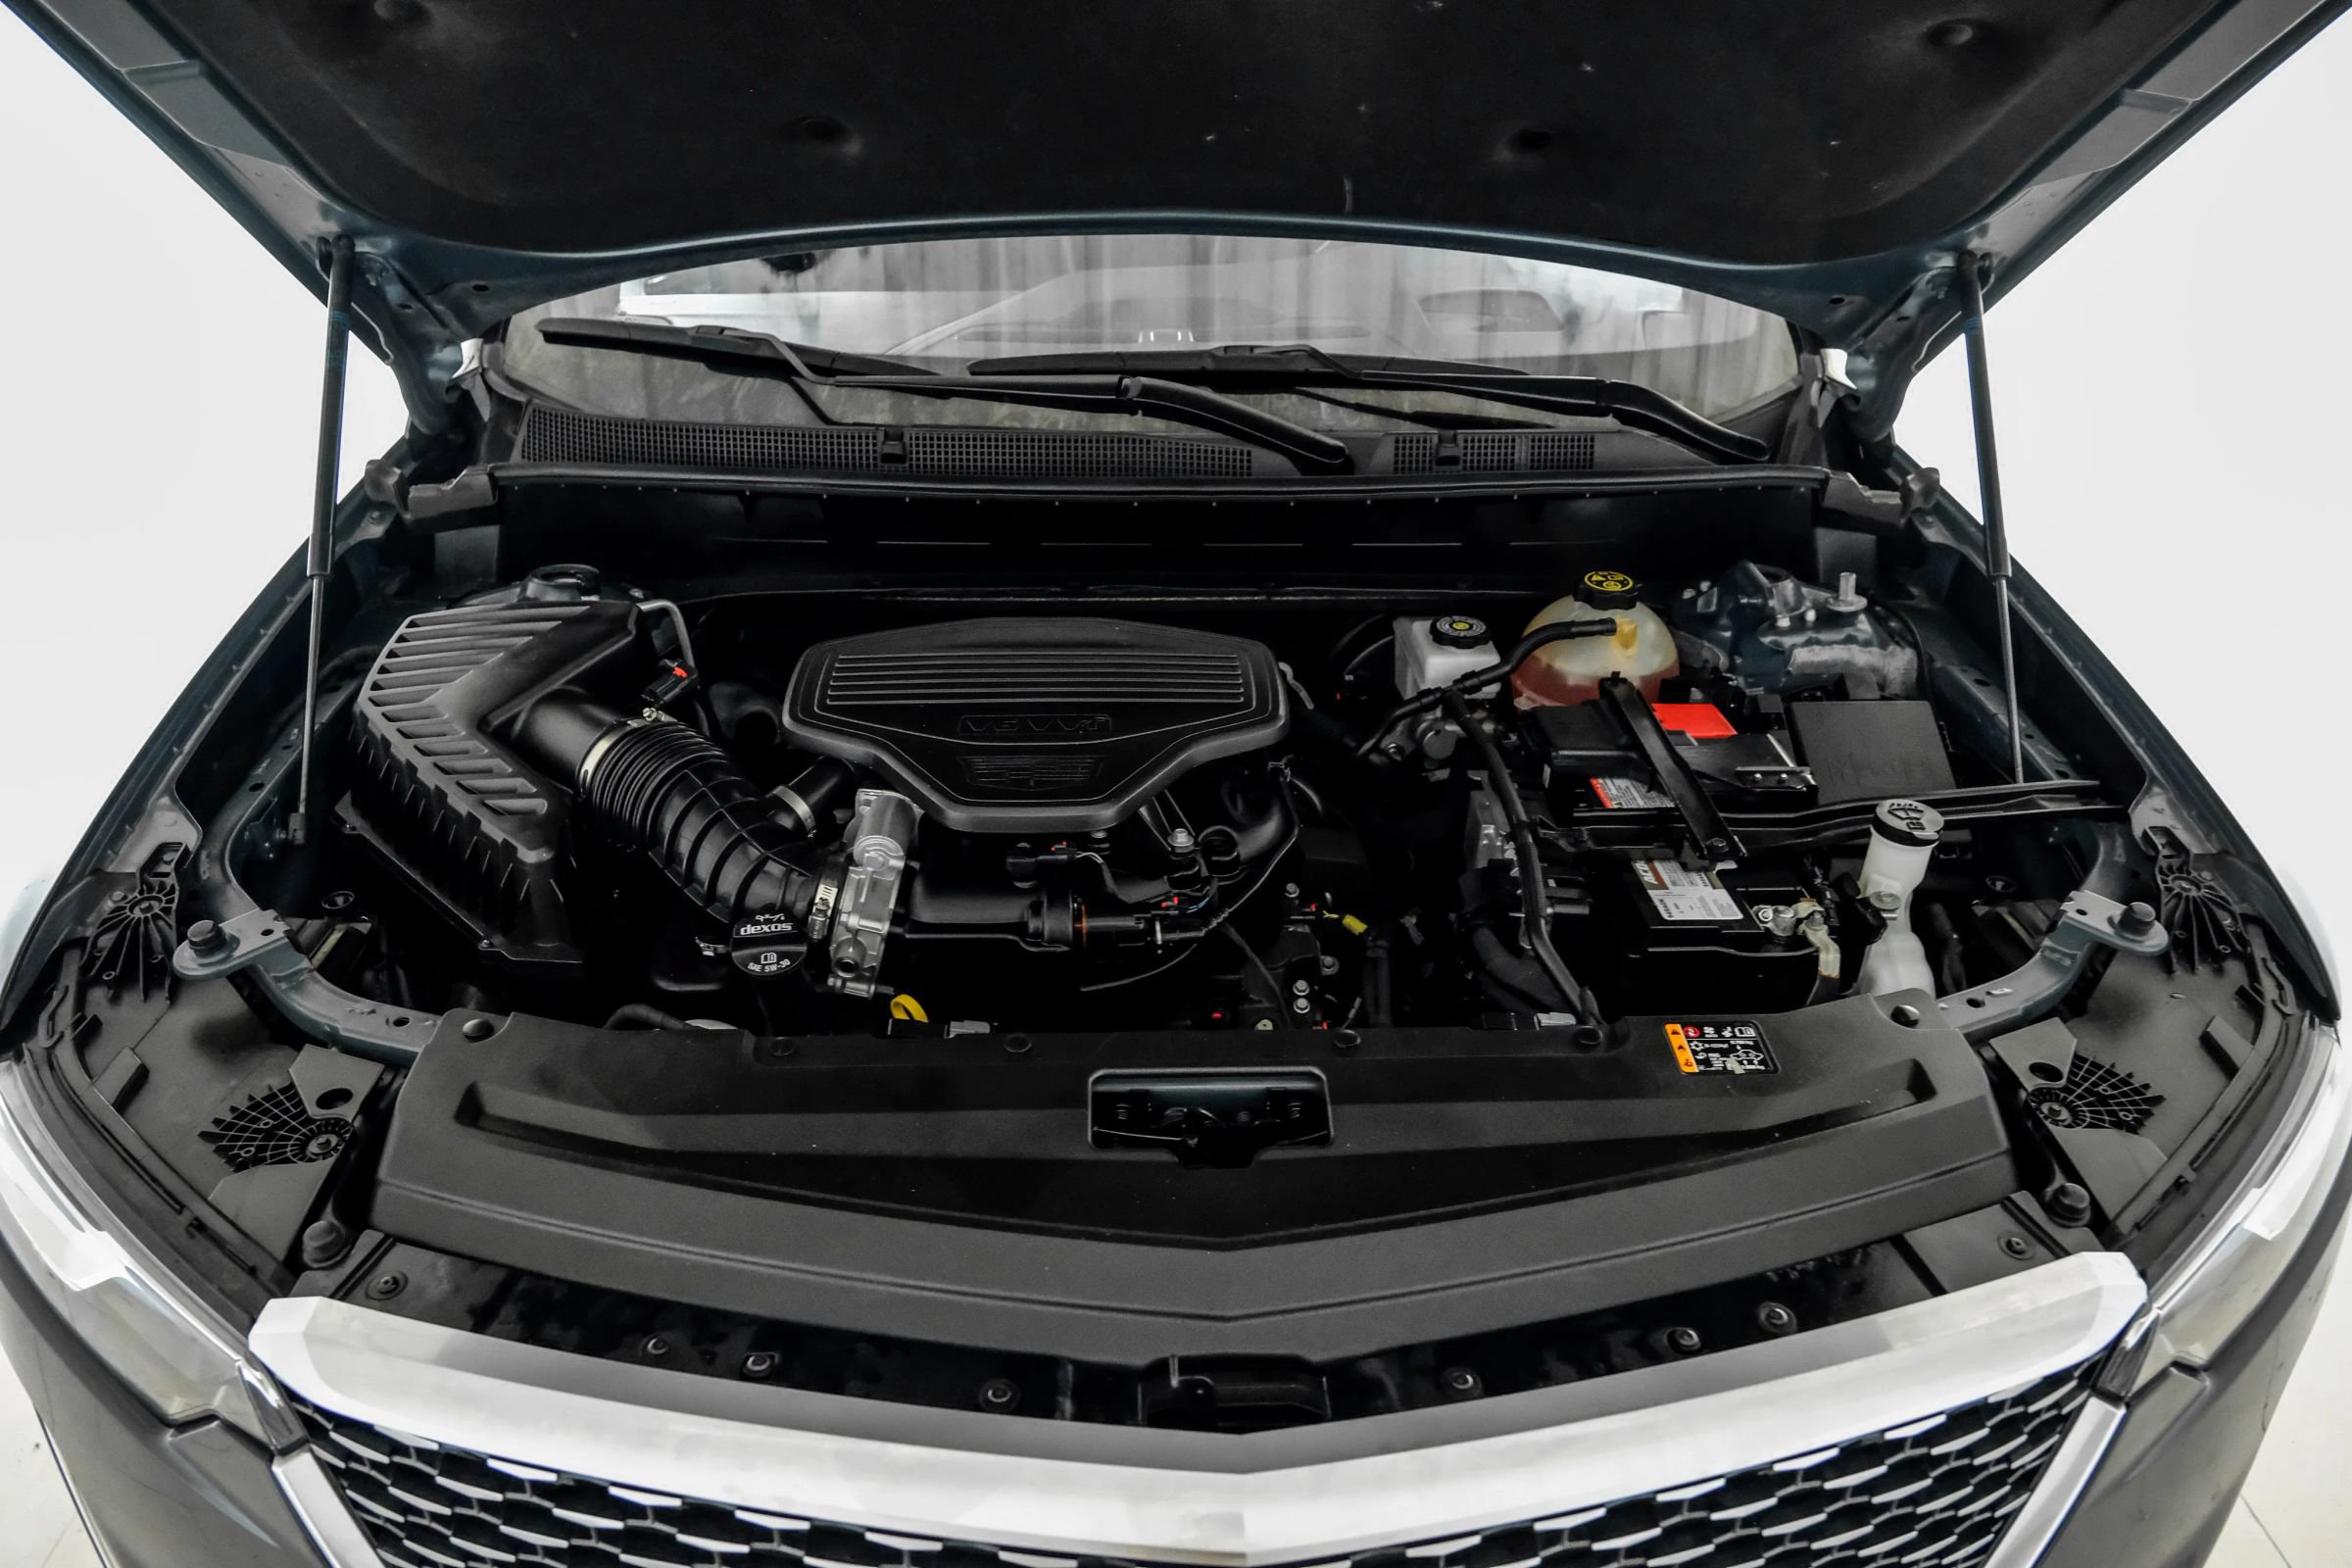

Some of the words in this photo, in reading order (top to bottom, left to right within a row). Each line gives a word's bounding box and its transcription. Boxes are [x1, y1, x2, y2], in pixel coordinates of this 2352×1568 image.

[740, 922, 795, 935] dexos
[747, 961, 763, 972] SAE
[764, 958, 791, 972] 5W-30
